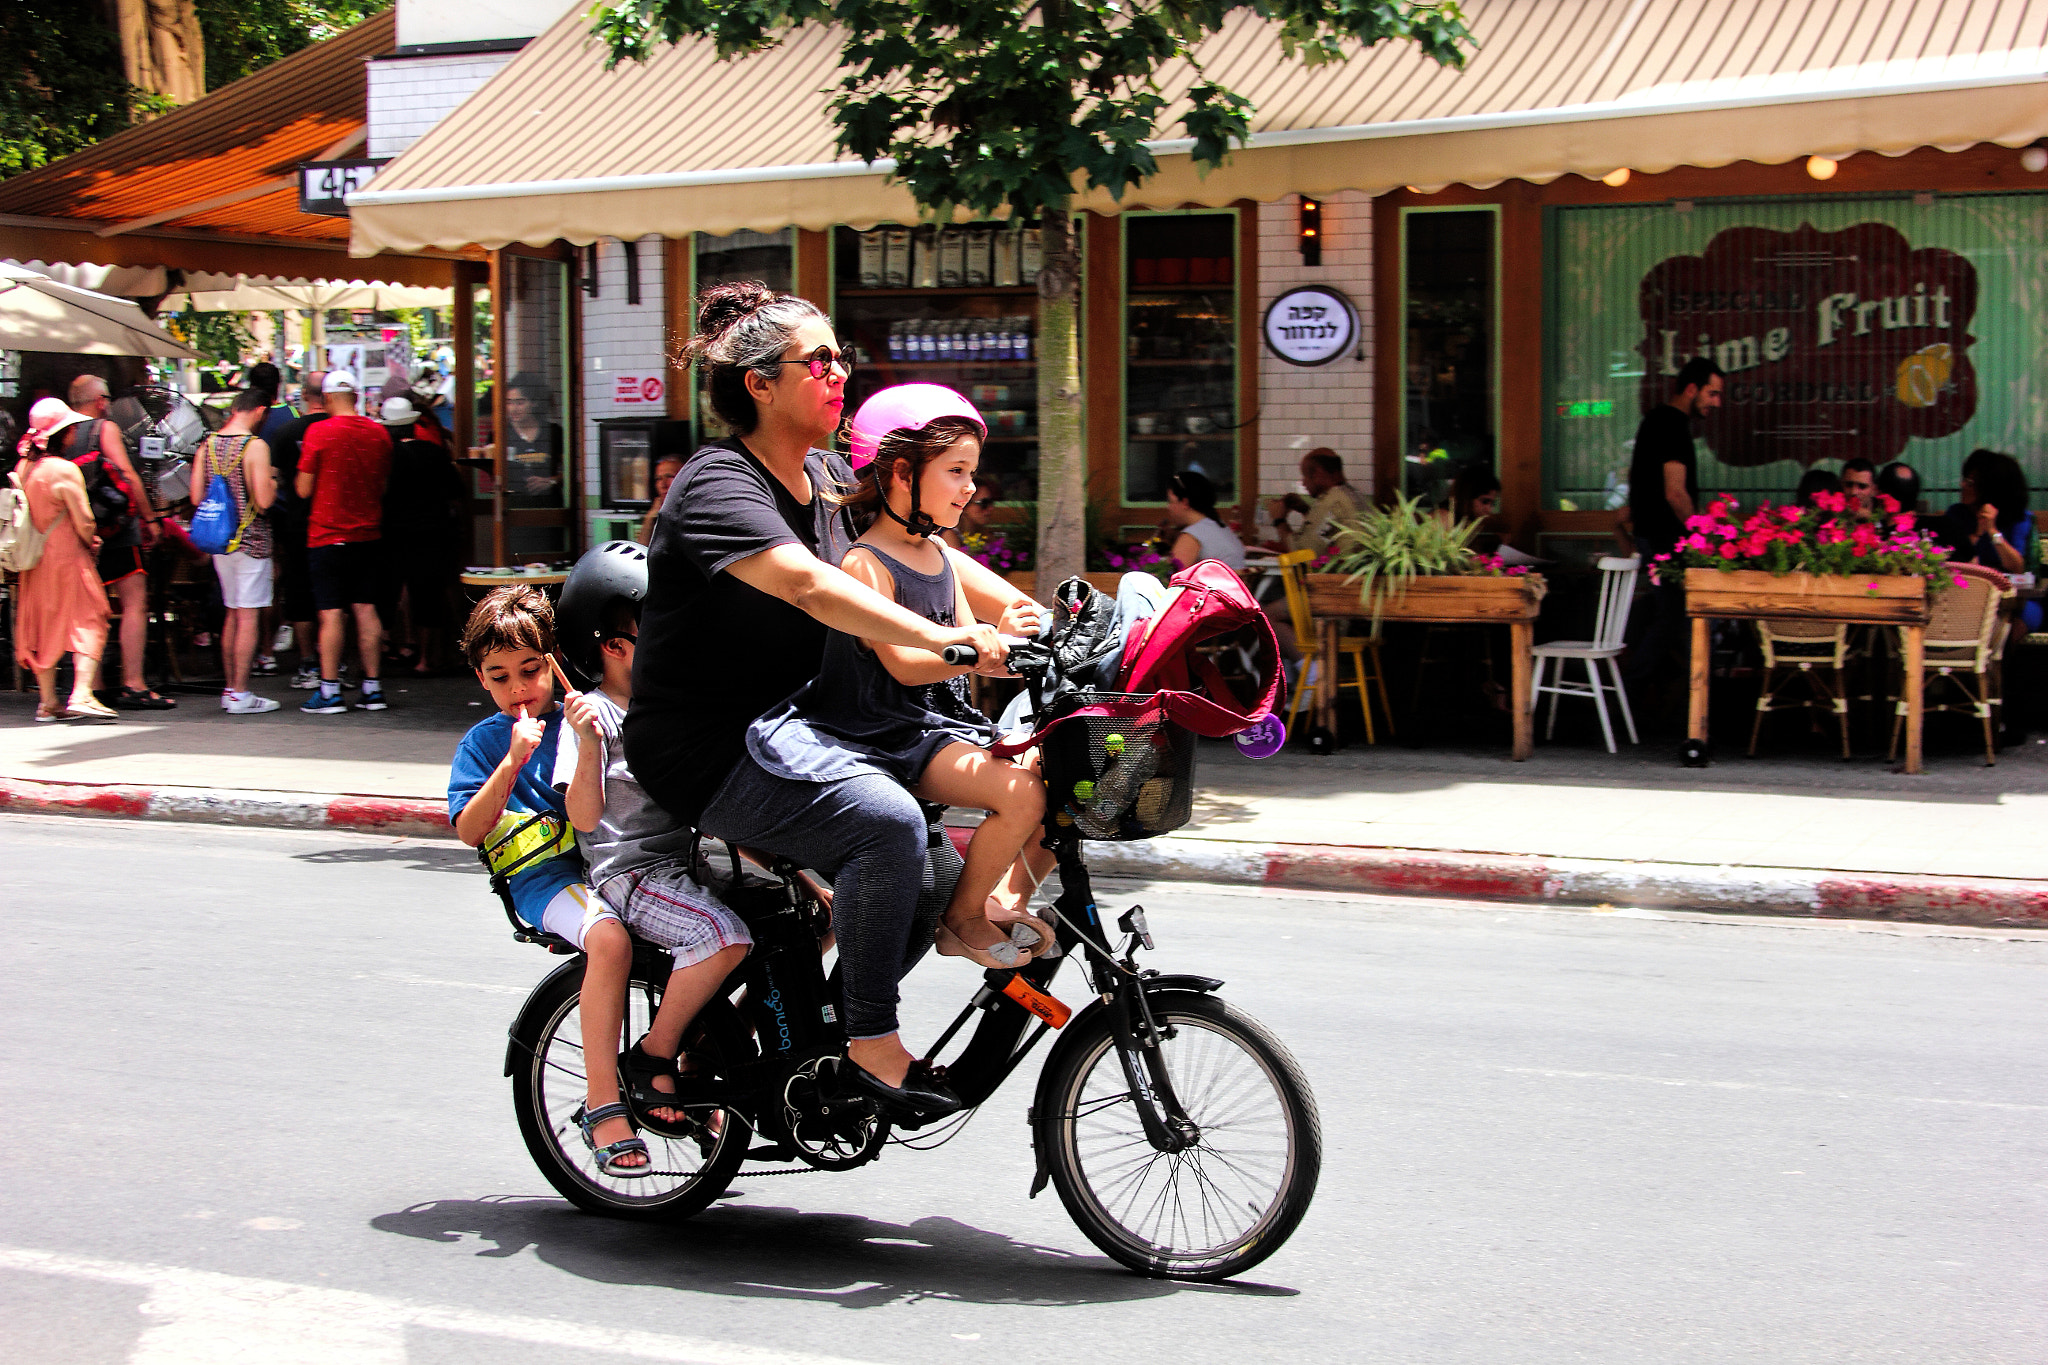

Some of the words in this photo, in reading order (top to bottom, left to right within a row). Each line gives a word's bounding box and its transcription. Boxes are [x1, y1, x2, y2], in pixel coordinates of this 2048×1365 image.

[1288, 306, 1327, 321] קפה
[1277, 322, 1338, 340] לנדוור
[1660, 327, 1790, 376] Lime
[1816, 282, 1950, 347] Fruit
